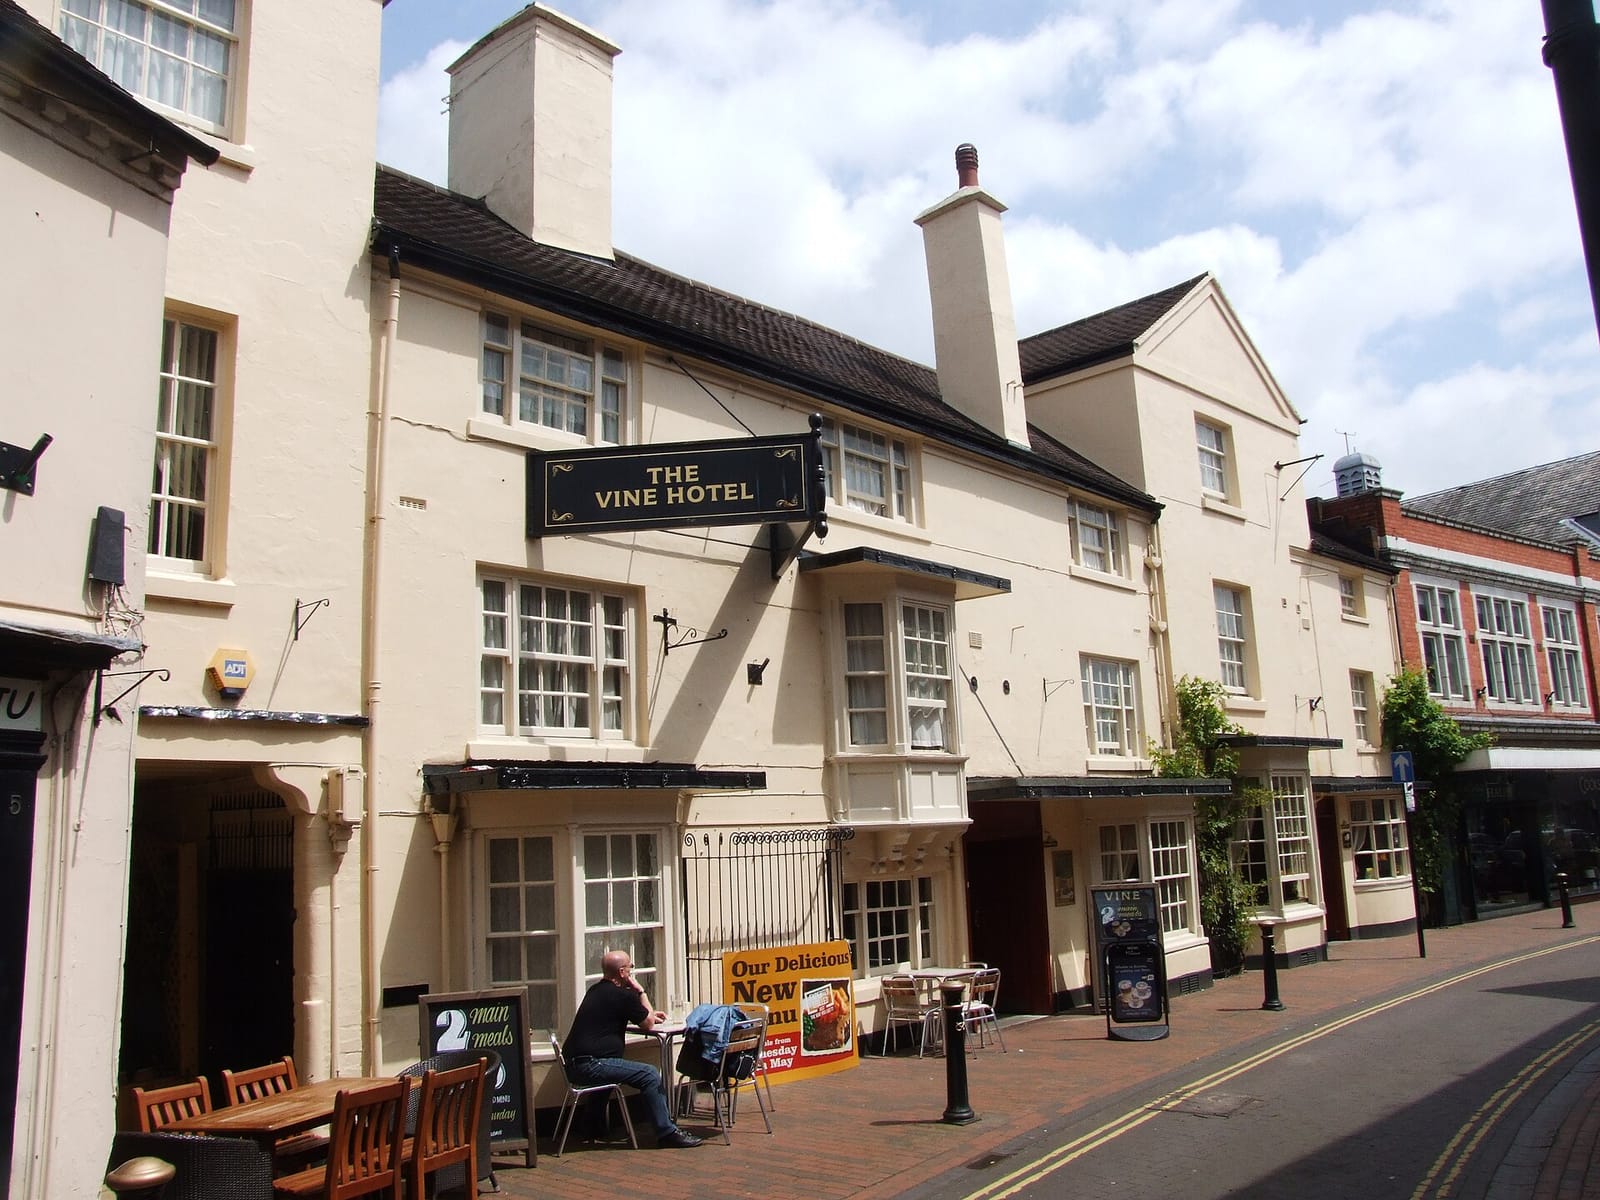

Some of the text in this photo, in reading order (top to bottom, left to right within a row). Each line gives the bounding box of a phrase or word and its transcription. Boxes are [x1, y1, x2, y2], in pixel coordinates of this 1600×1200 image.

[646, 464, 700, 485] THE
[594, 482, 754, 509] VINE HOTEL
[225, 663, 246, 675] ADT
[9, 793, 22, 815] 5
[1103, 890, 1142, 902] VINE
[1100, 905, 1116, 926] 2
[731, 951, 850, 977] Our Delicious
[731, 979, 798, 1004] New
[469, 1003, 510, 1025] main
[768, 1008, 798, 1025] nu
[436, 1008, 472, 1052] 2
[472, 1024, 513, 1048] meals
[774, 1036, 791, 1046] from
[759, 1044, 798, 1060] nesday
[770, 1056, 794, 1070] May
